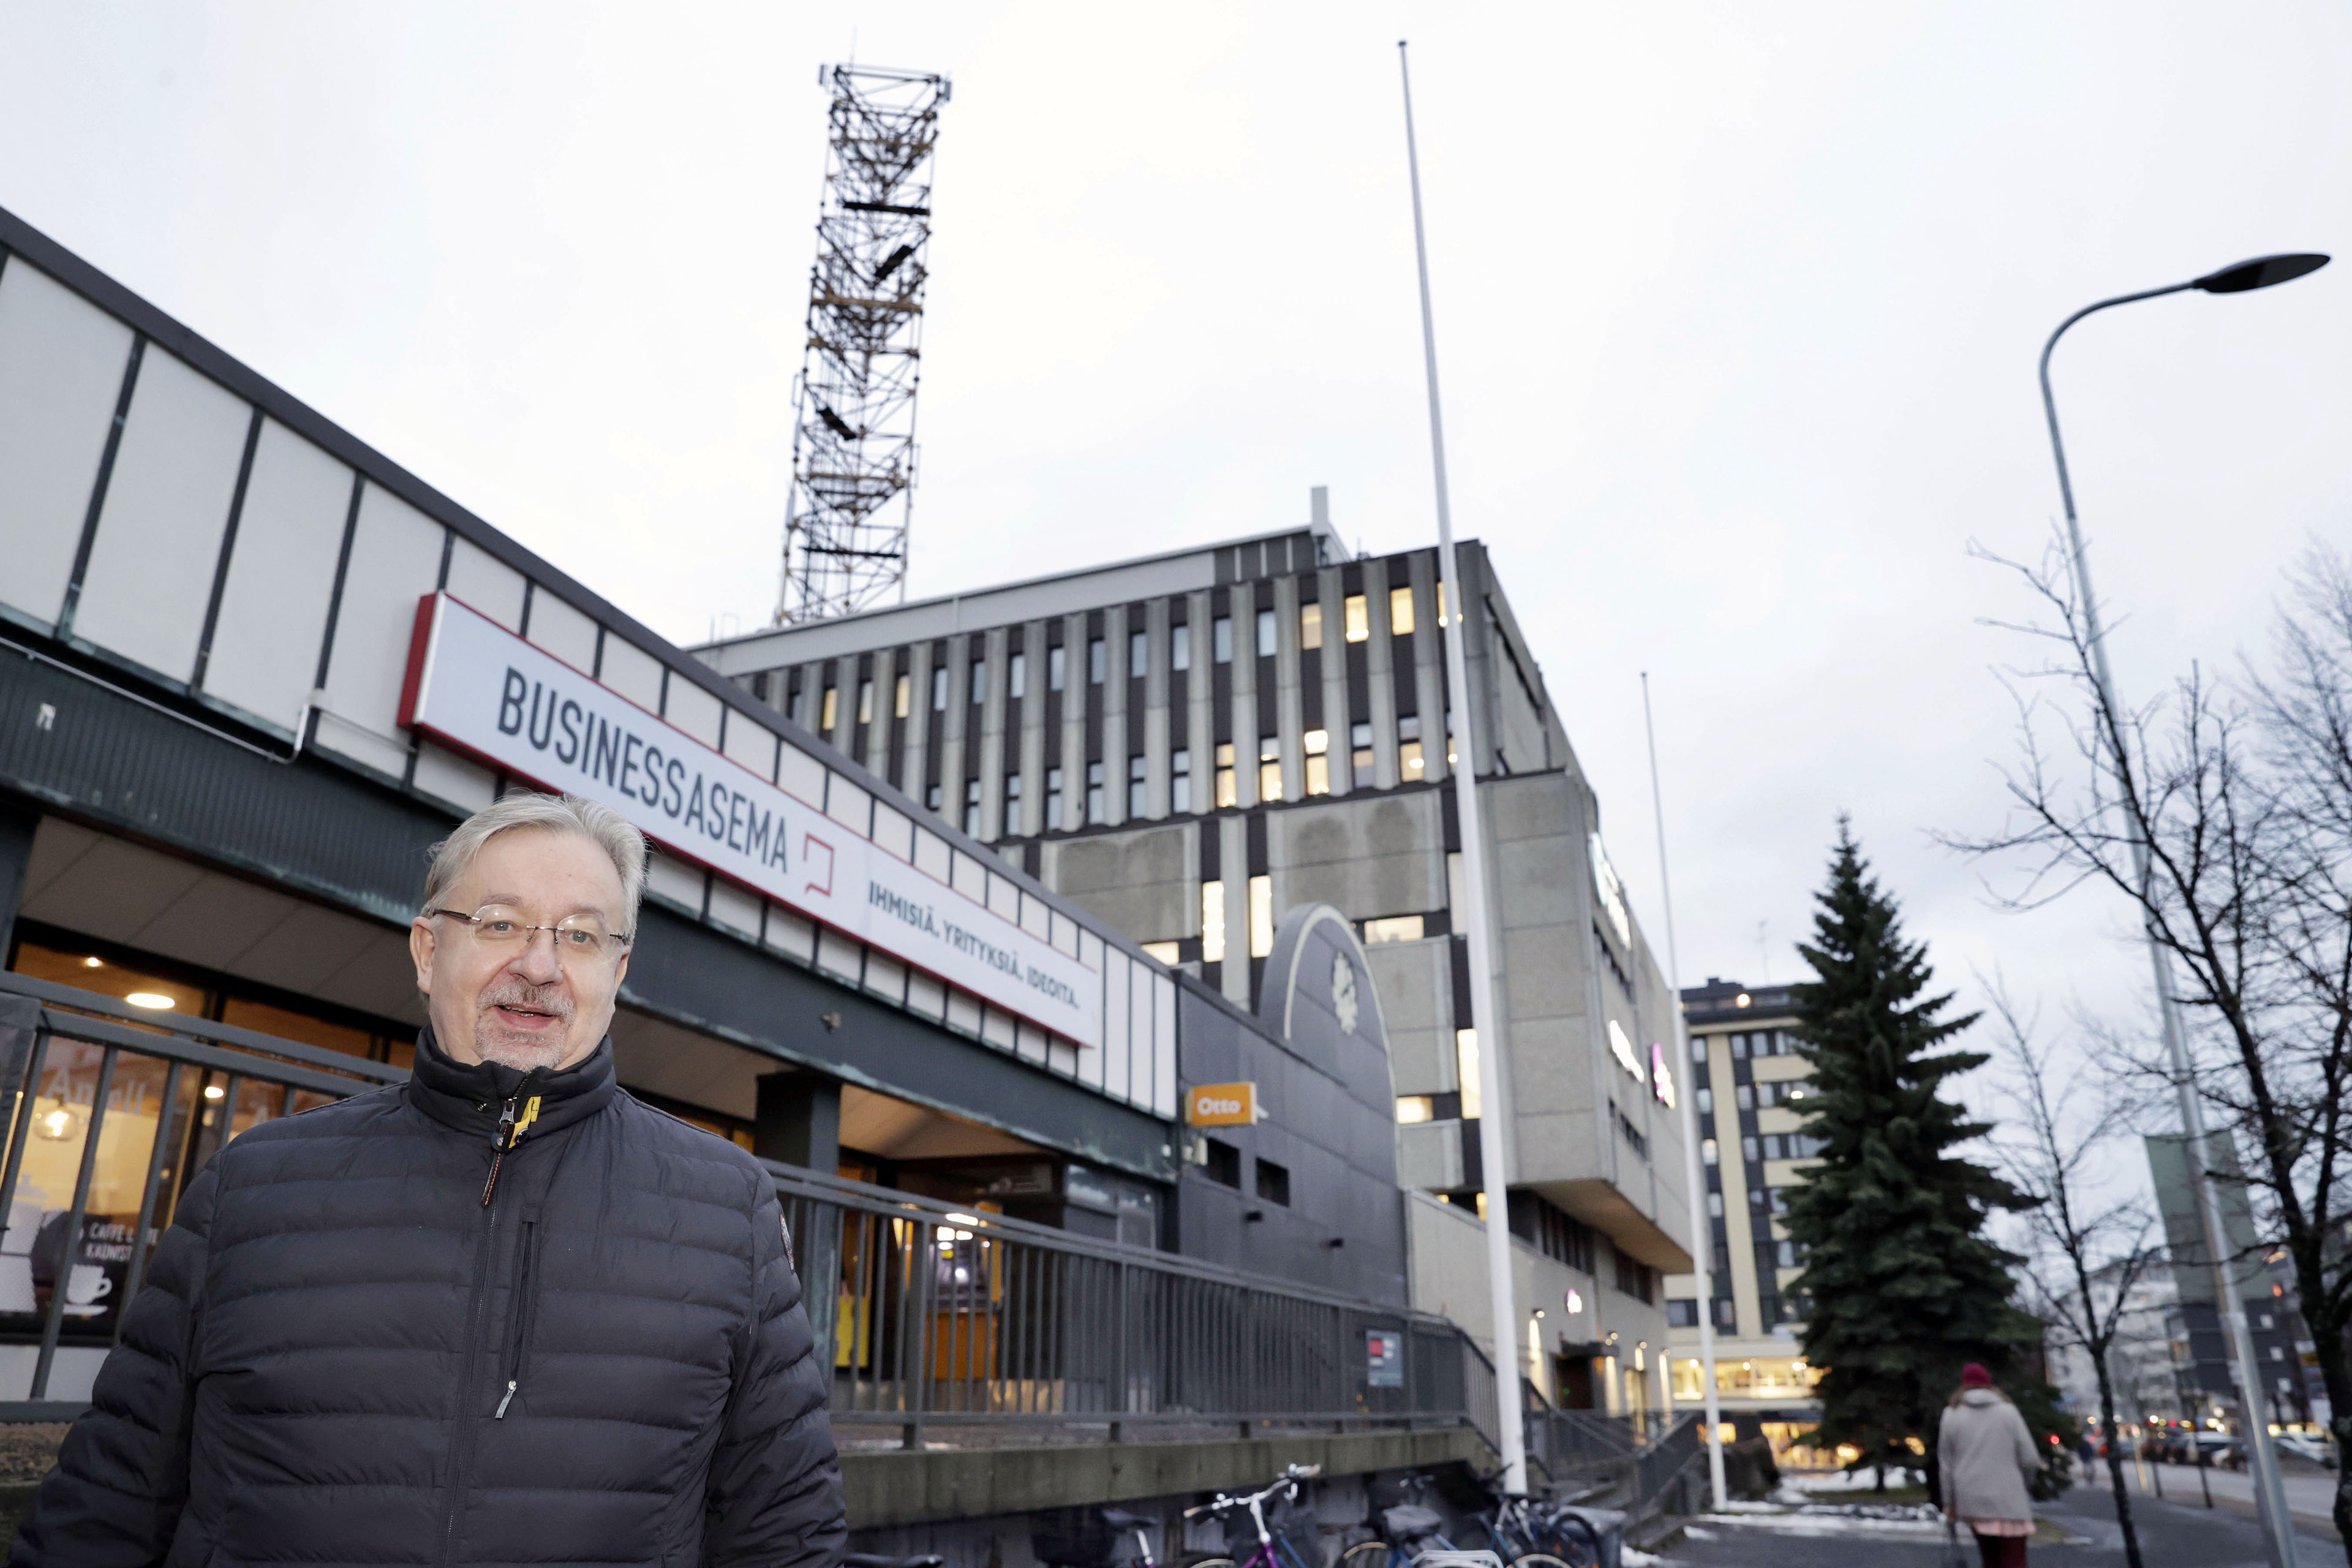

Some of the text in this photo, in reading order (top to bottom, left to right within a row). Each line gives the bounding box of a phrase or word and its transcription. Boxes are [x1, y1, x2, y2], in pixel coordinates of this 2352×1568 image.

[498, 666, 788, 874] BUSINESSASEMA
[869, 881, 1080, 1009] IHMISIÄ. YRITYKSIÄ. IDEOITA.
